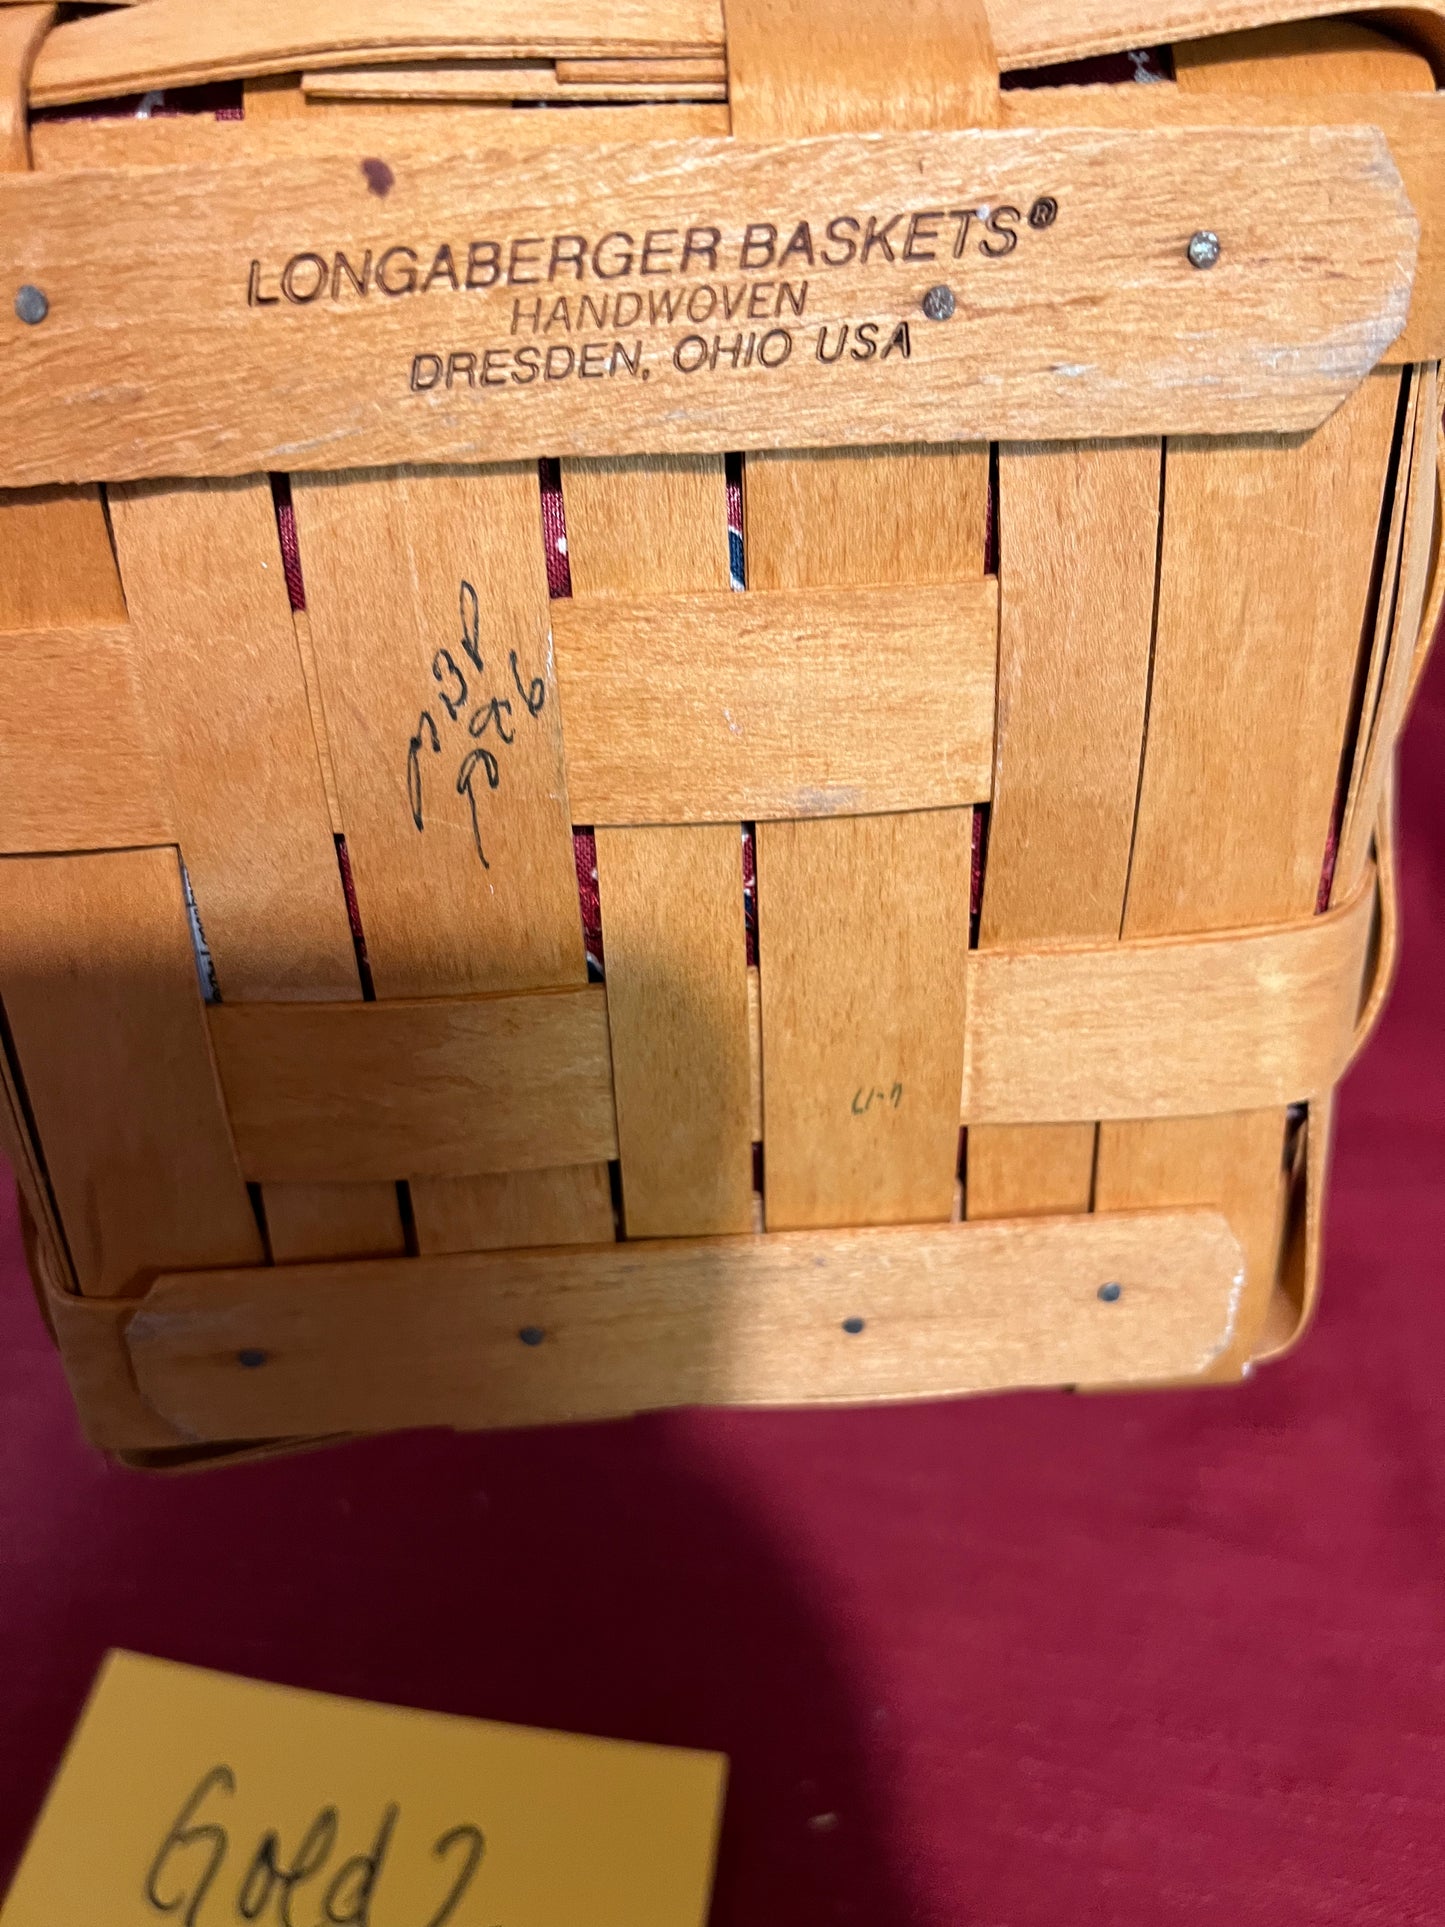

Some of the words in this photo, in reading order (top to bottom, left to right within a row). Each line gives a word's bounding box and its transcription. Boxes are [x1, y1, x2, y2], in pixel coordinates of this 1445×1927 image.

[248, 226, 722, 307] LONGABERGER
[510, 280, 808, 336] HANDWOVEN
[410, 340, 650, 392] DRESDEN,
[672, 328, 793, 373] OHIO
[815, 320, 912, 364] USA
